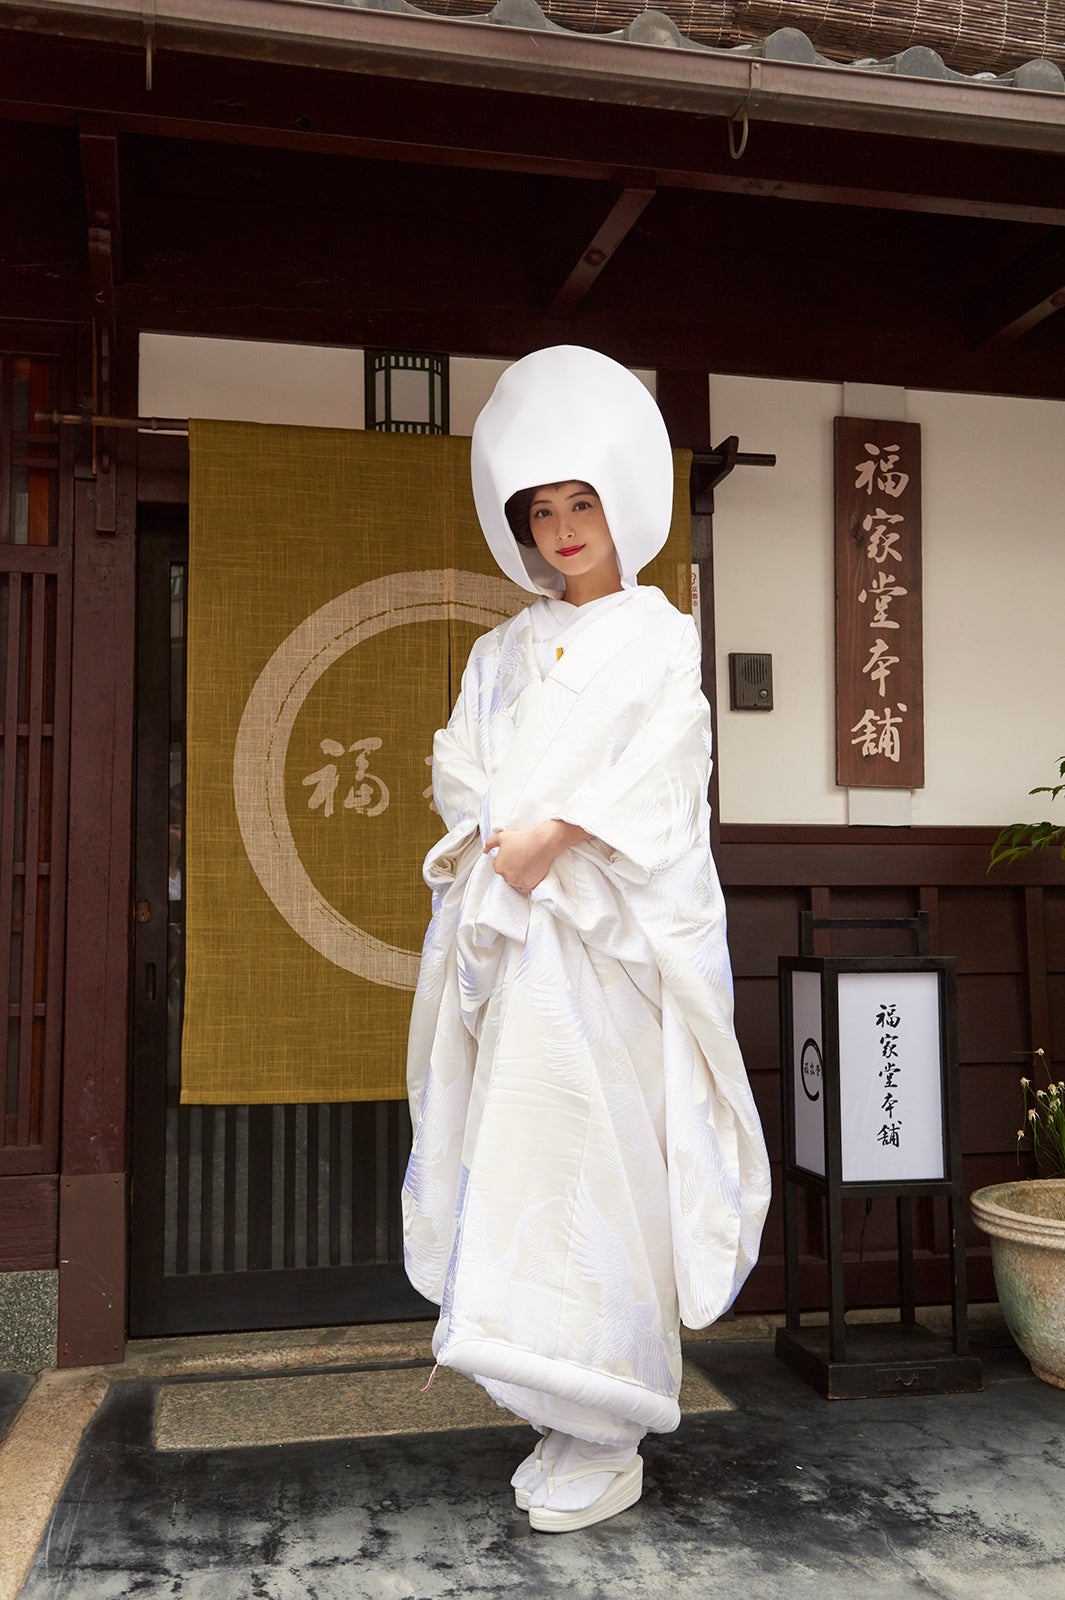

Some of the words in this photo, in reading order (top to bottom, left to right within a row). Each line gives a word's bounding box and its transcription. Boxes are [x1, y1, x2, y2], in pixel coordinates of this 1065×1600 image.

[851, 443, 909, 763] 福家堂本舗
[302, 737, 433, 818] 福
[875, 1003, 903, 1147] 福家堂本舗
